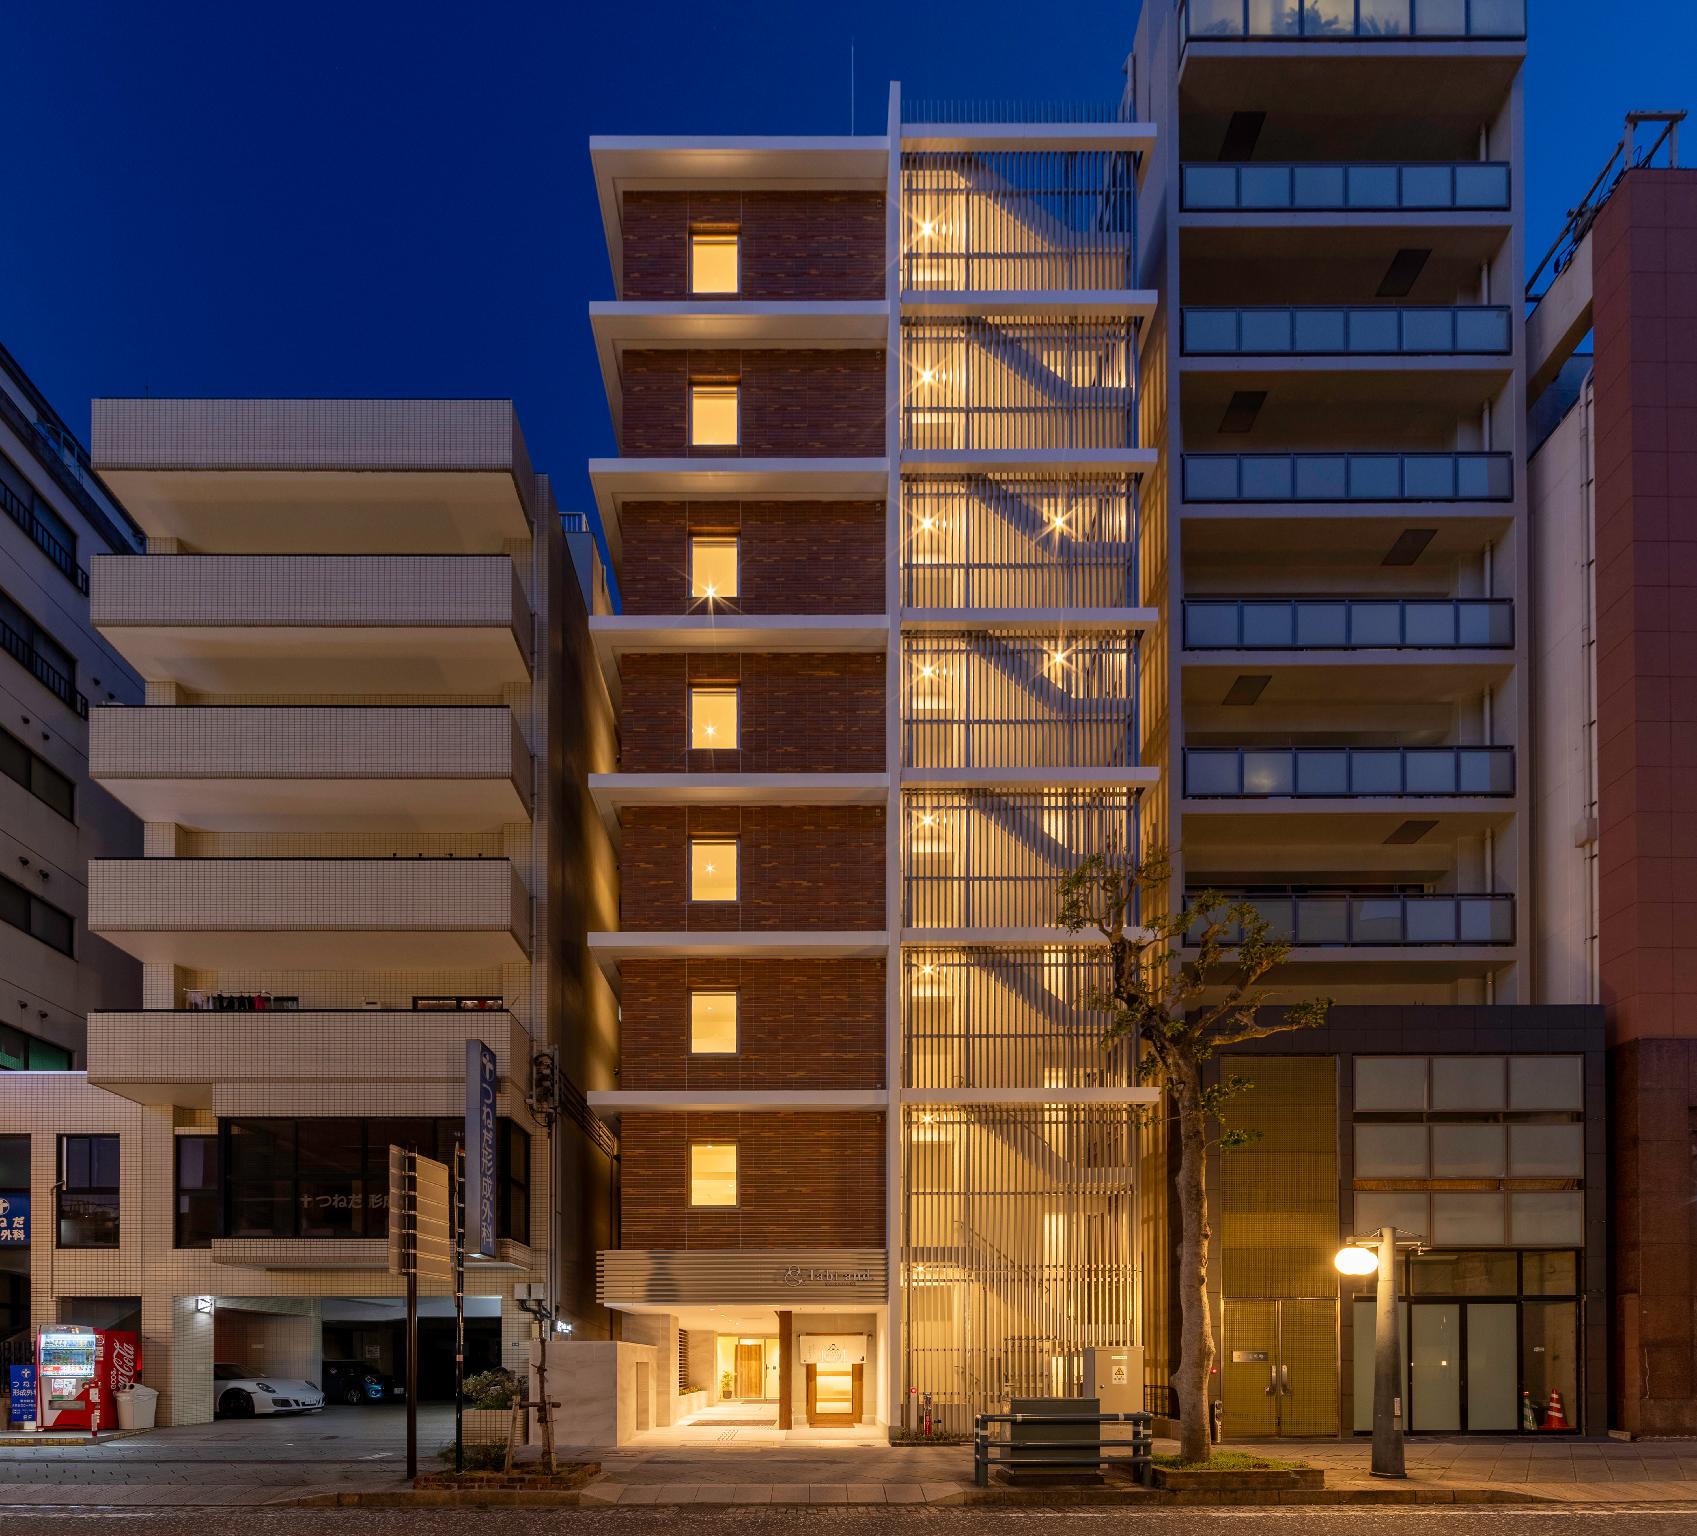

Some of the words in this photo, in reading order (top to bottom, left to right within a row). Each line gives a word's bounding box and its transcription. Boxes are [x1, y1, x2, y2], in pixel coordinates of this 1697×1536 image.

[481, 1083, 495, 1248] つねだ形成外科
[12, 1388, 37, 1397] 形成外
